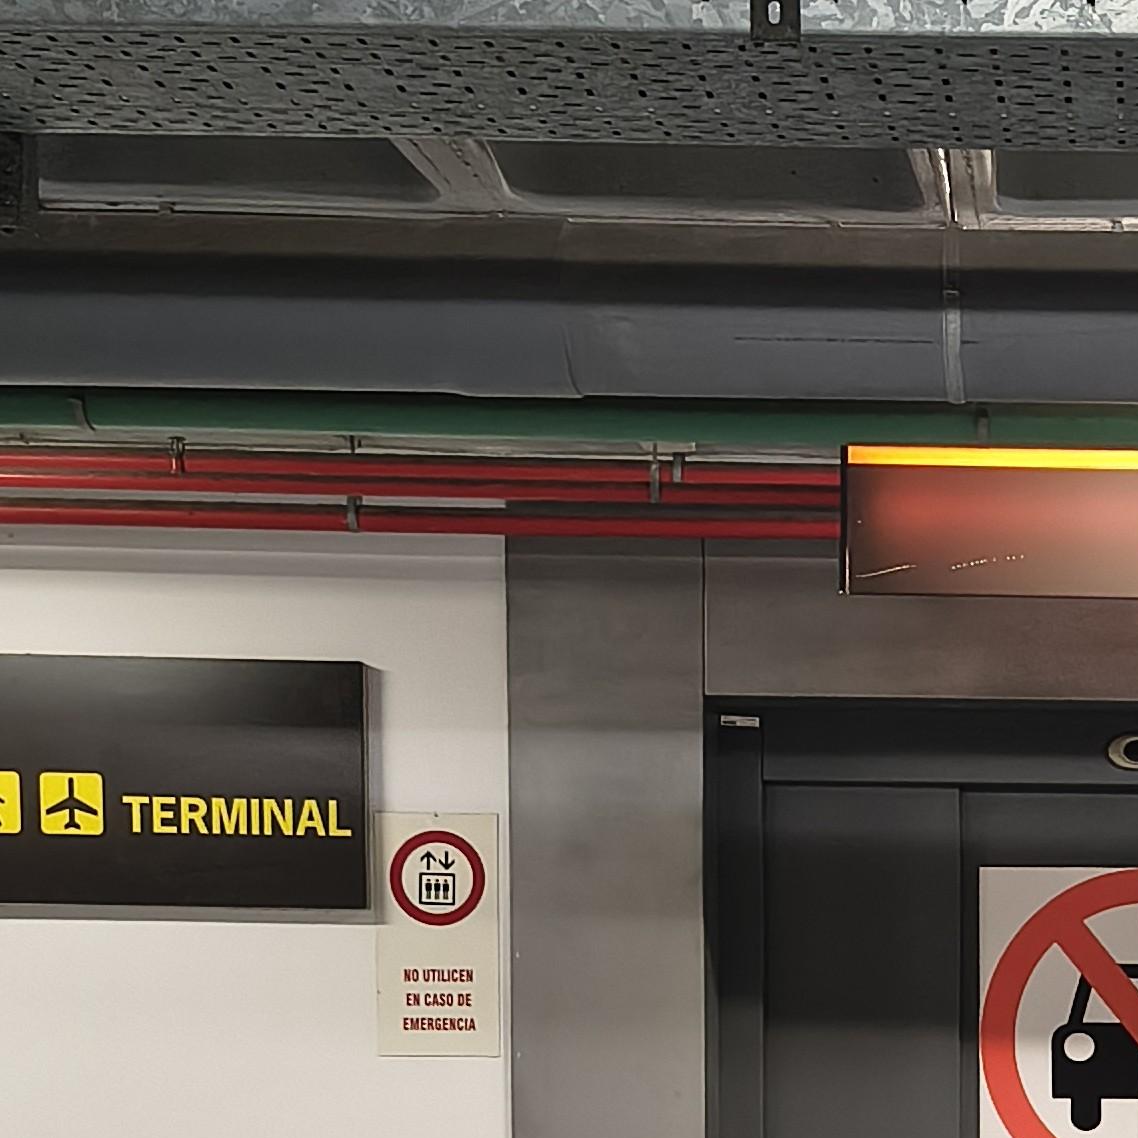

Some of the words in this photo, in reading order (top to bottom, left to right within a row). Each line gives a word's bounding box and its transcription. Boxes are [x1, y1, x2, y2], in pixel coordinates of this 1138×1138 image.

[122, 795, 352, 838] TERMINAL
[403, 968, 419, 983] NO
[422, 968, 474, 983] UTILICEN
[406, 992, 420, 1007] EN
[424, 992, 454, 1007] CASO
[457, 992, 472, 1007] DE
[402, 1017, 476, 1032] EMERGENCIA
